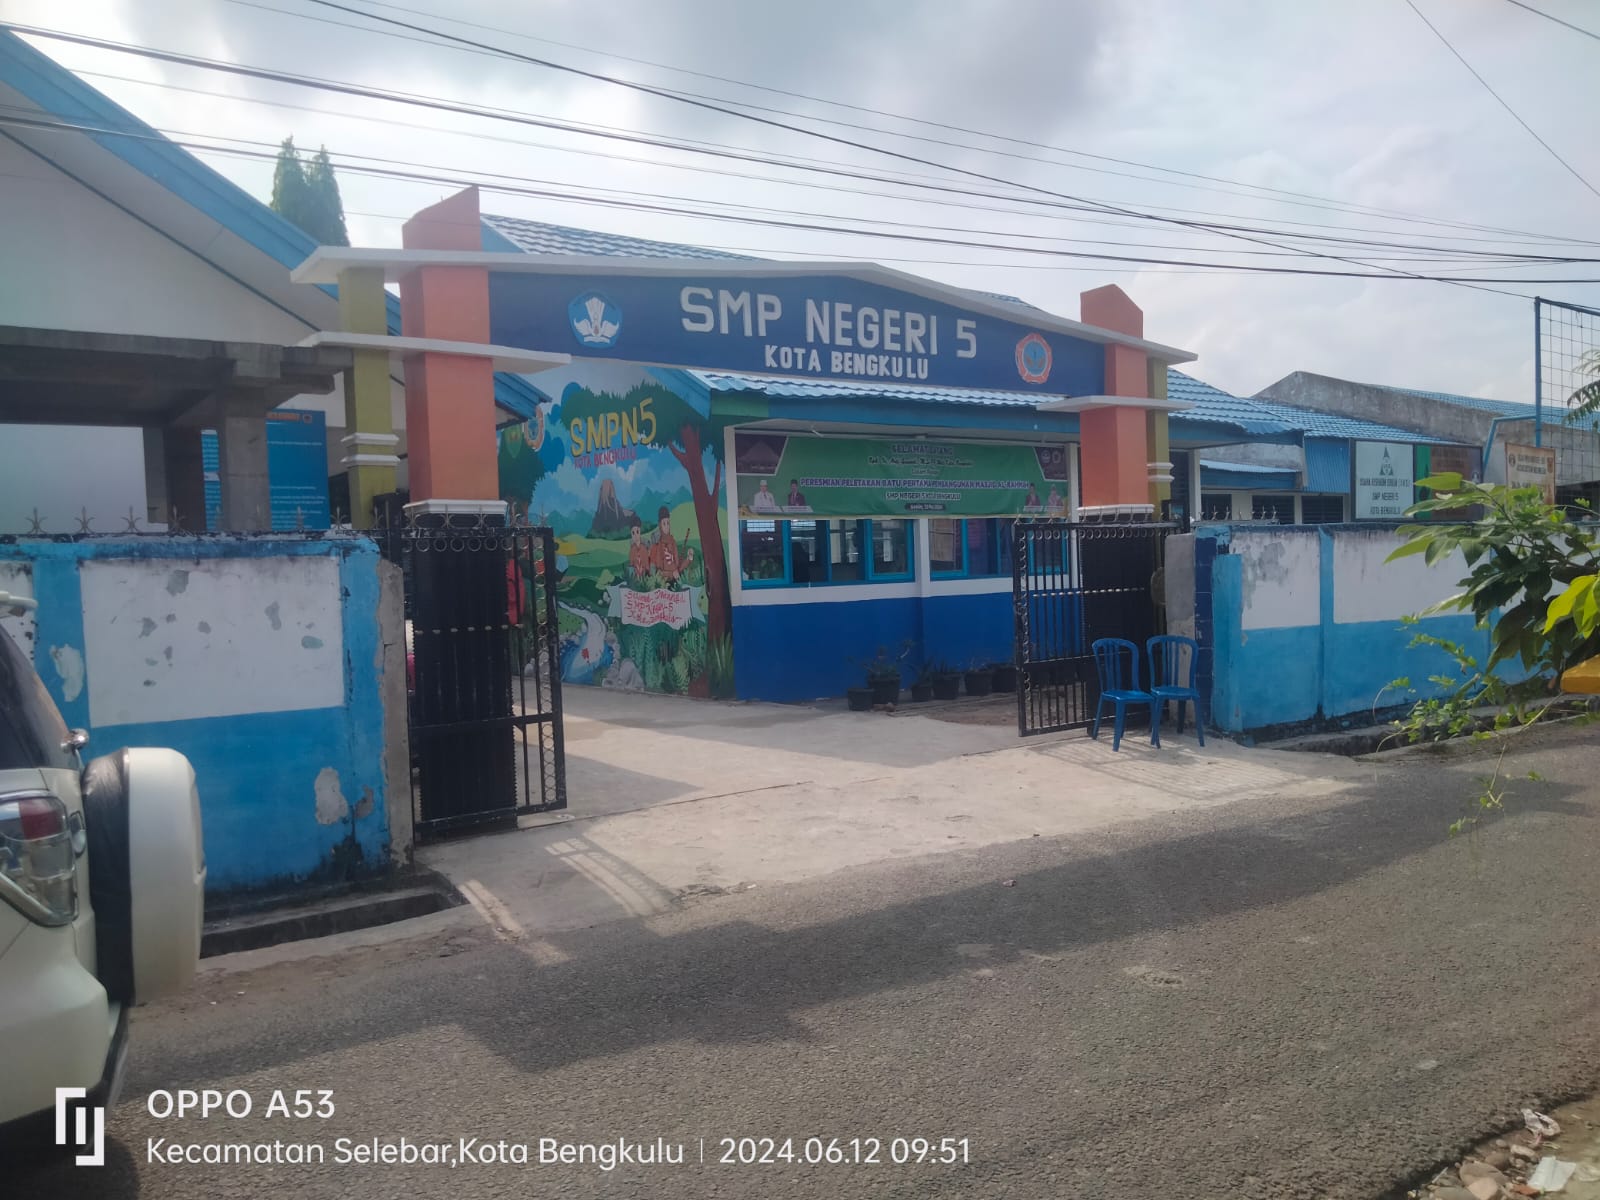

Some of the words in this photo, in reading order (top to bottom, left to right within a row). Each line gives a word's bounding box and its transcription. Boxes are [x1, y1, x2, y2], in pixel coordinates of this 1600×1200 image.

[680, 286, 782, 337] SMP
[806, 298, 938, 355] NEGERI
[956, 318, 977, 359] 5
[765, 344, 822, 372] KOTA
[831, 351, 928, 379] BENGKULU
[593, 447, 637, 467] BENGKULU
[799, 477, 839, 487] PERESMIAN
[881, 478, 900, 488] BATU
